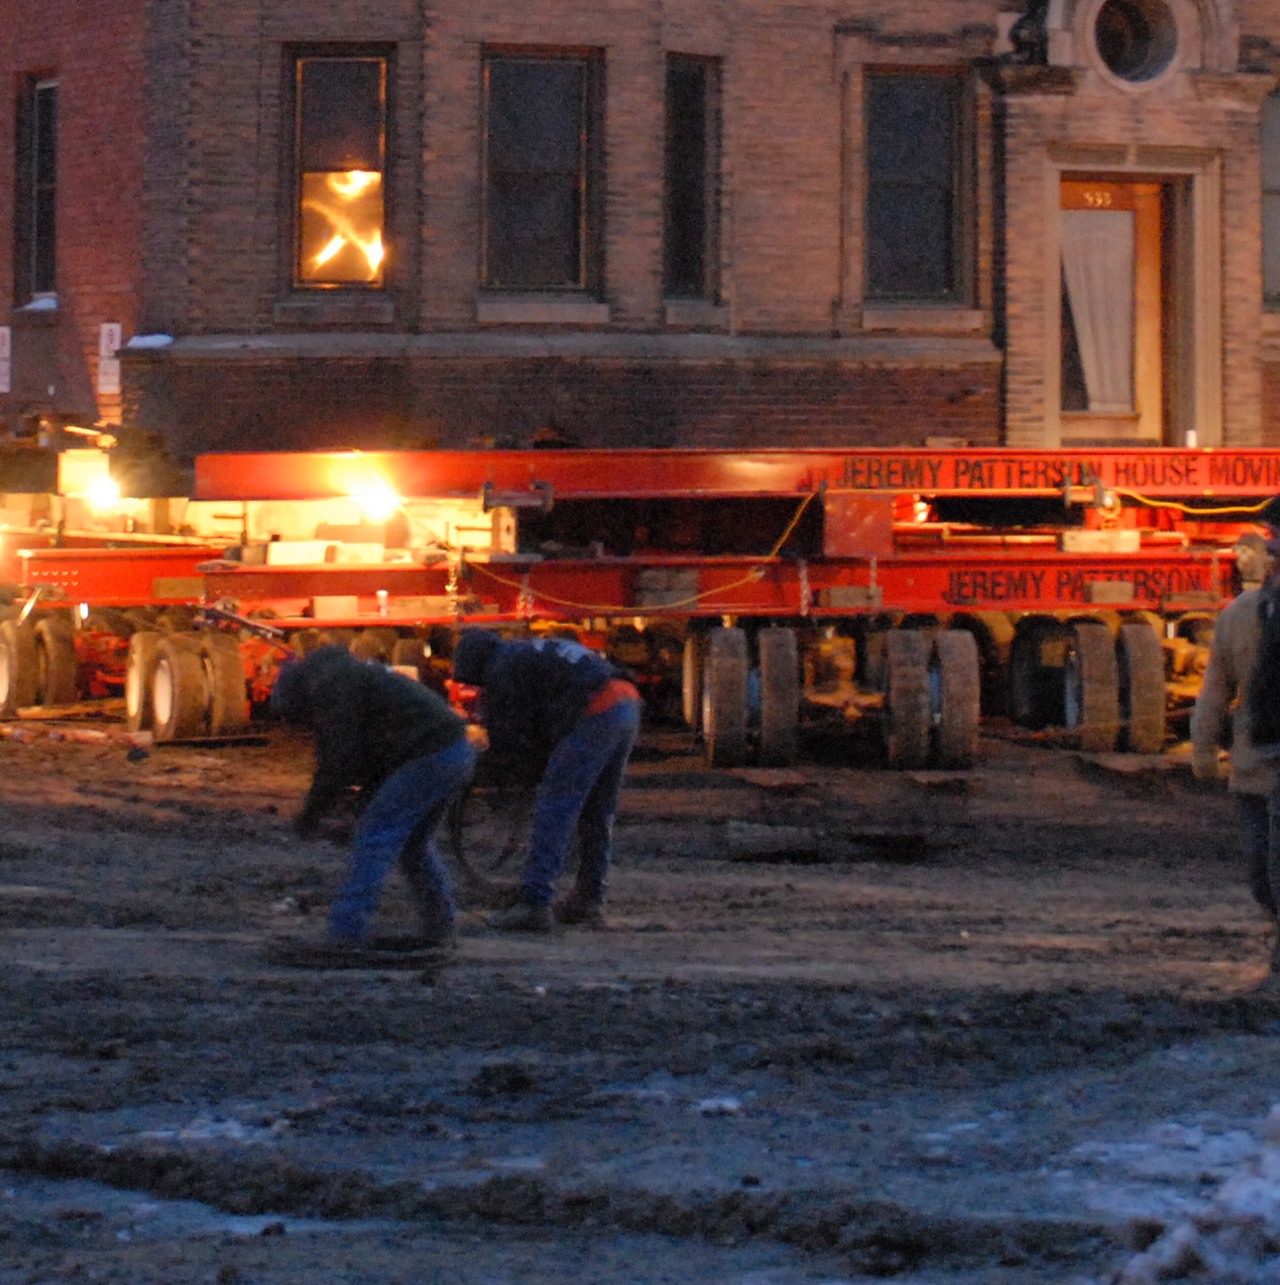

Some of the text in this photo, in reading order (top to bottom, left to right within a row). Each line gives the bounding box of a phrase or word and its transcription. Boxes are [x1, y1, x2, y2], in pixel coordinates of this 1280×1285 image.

[836, 458, 942, 489] JEREMY
[1115, 457, 1198, 486] HOUSE
[942, 569, 1046, 602] JEREMY
[1056, 569, 1202, 601] PARSON
